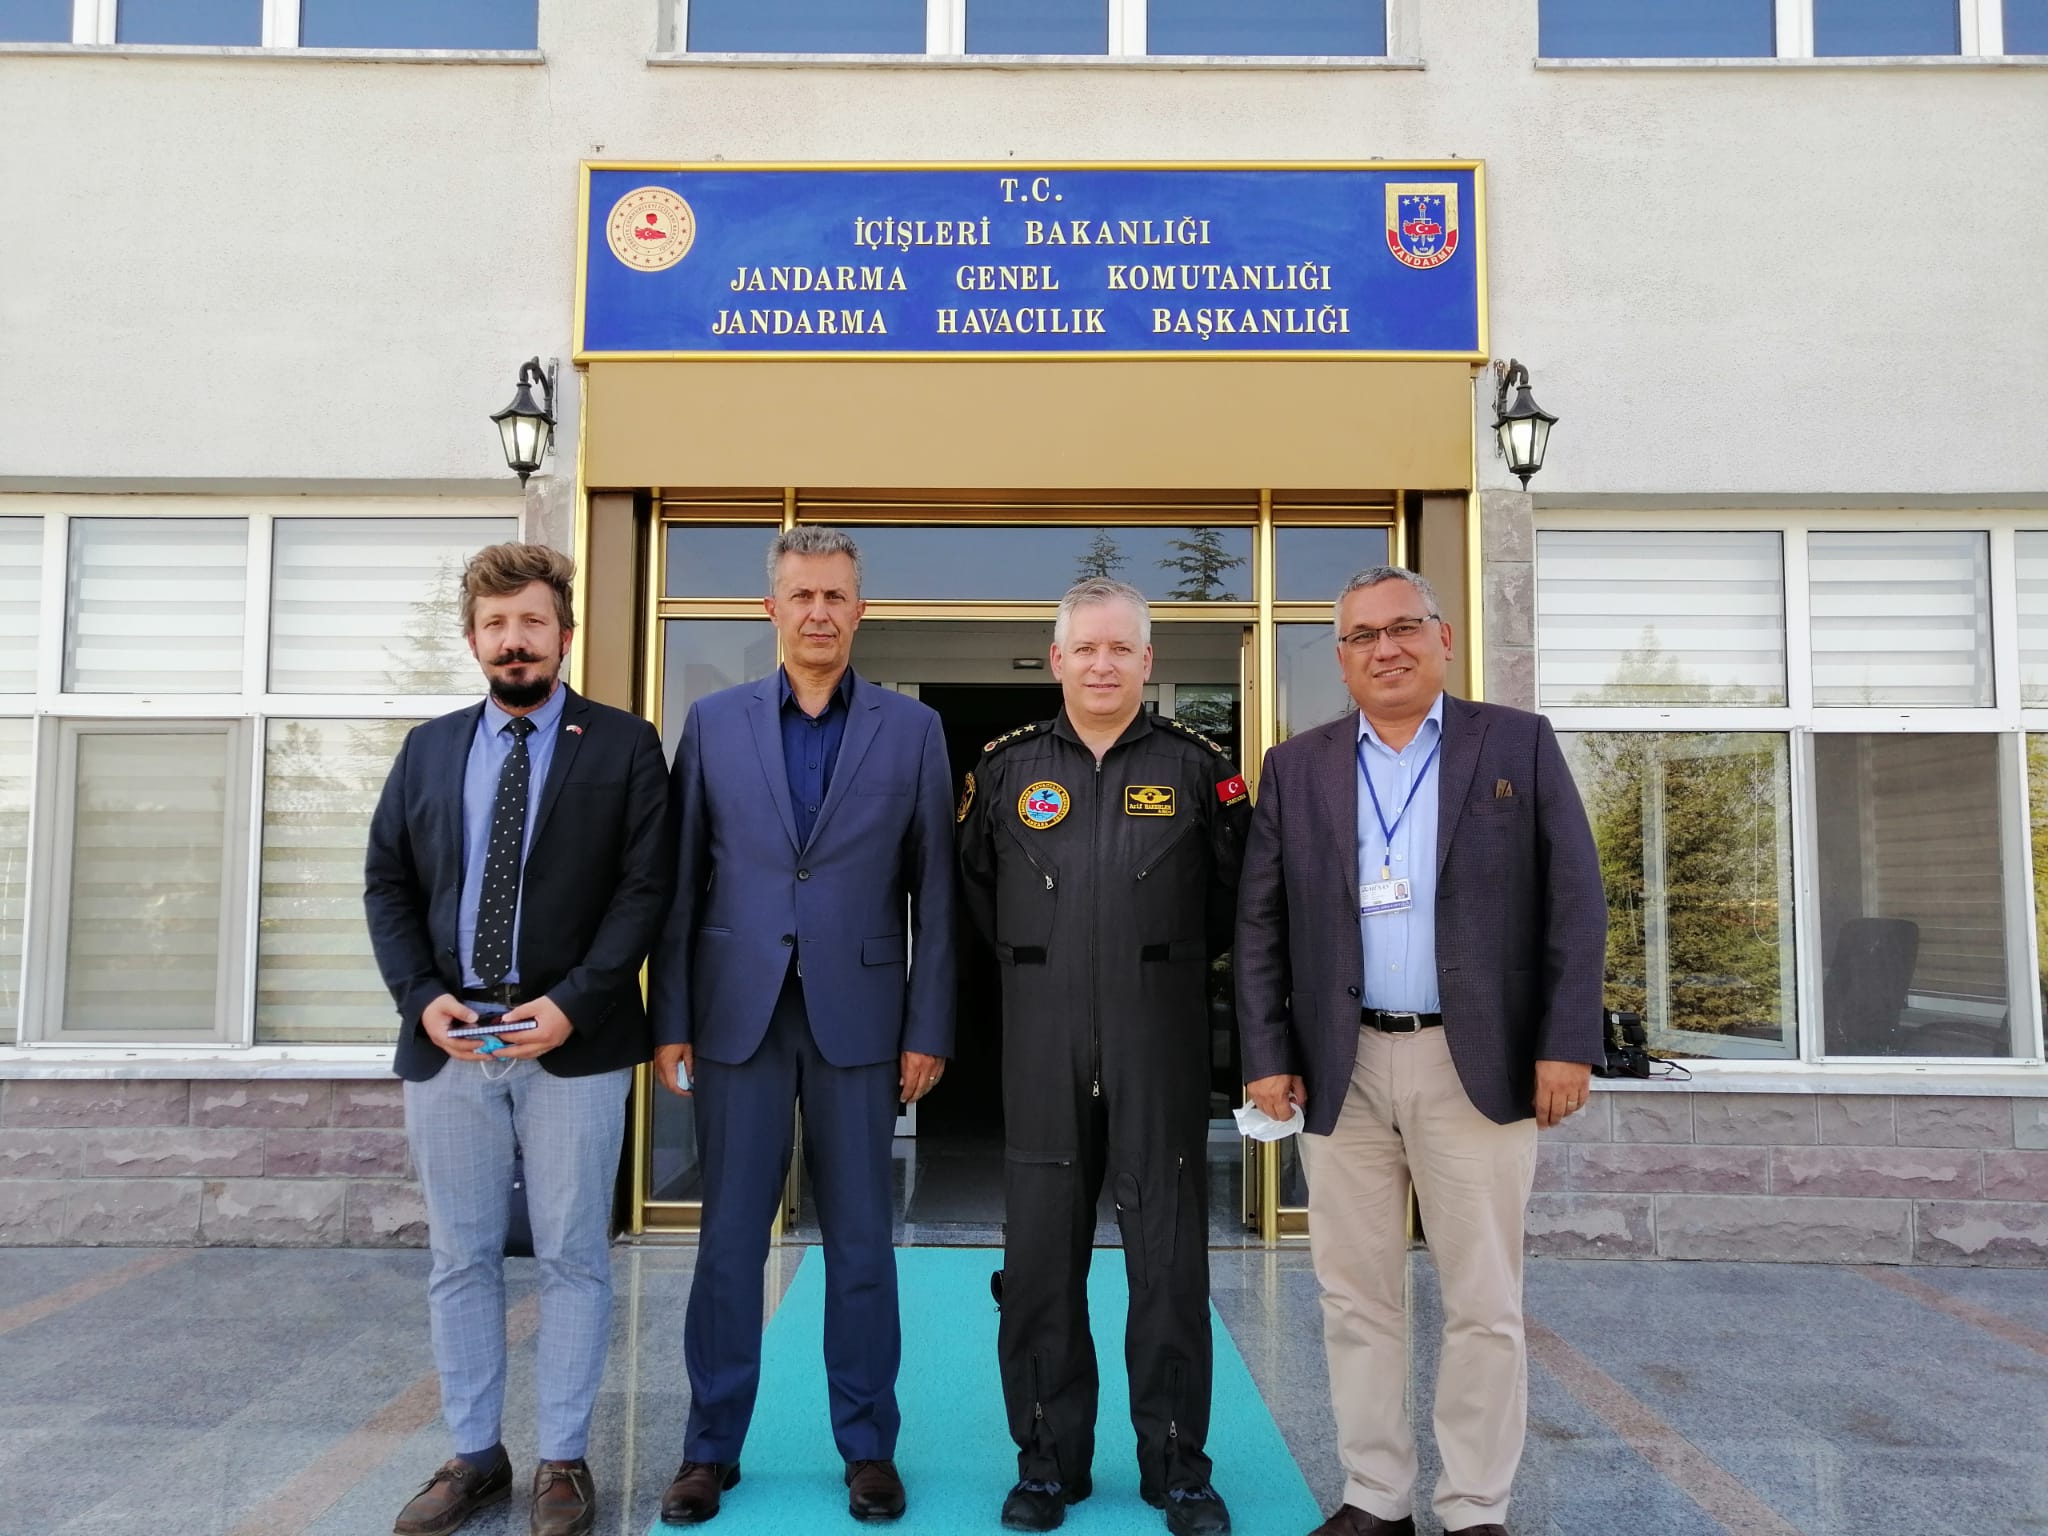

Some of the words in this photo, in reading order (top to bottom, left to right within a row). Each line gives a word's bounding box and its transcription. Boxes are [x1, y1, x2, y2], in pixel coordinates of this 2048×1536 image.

[1000, 177, 1064, 204] T.C.
[854, 216, 991, 252] İÇİŞLERİ
[1025, 216, 1211, 245] BAKANLIĞI
[1392, 245, 1454, 267] JANDARMA
[730, 266, 908, 292] JANDARMA
[956, 265, 1059, 290] GENEL
[1107, 261, 1332, 290] KOMUTANLIĞI
[712, 309, 888, 335] JANDARMA
[936, 307, 1106, 334] HAVACILIK
[1152, 304, 1350, 340] BAŞKANLIĞI
